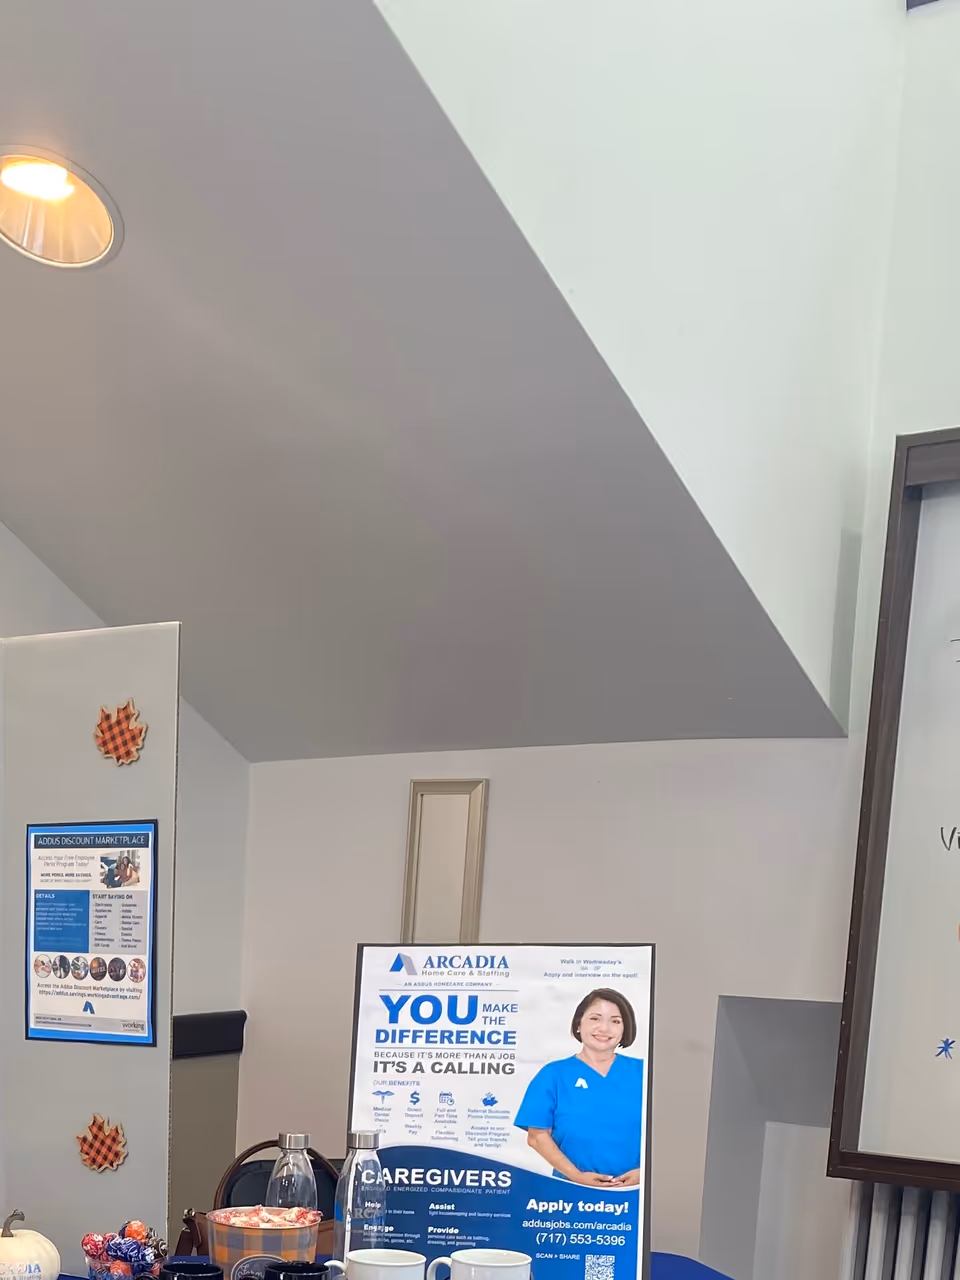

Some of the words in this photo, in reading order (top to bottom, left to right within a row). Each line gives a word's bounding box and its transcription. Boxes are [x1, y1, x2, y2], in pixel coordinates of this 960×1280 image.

[38, 837, 60, 845] ADDUS
[61, 837, 95, 845] DISCOUNT
[95, 836, 145, 845] MARKETPLACE
[423, 955, 509, 969] ARCADIA
[477, 970, 510, 978] Staffing
[92, 985, 118, 993] Marketplace
[379, 994, 479, 1025] YOU
[482, 1003, 519, 1013] MAKE
[481, 1016, 506, 1025] THE
[122, 1022, 145, 1032] working
[375, 1029, 517, 1045] DIFFERENCE
[374, 1051, 415, 1059] BECAUSE
[373, 1060, 407, 1074] IT'S
[412, 1061, 425, 1074] A
[430, 1061, 515, 1075] CALLING
[361, 1167, 512, 1188] CAREGIVERS
[429, 1202, 455, 1211] Assist
[526, 1198, 574, 1214] Apply
[577, 1200, 629, 1216] today!
[427, 1226, 459, 1234] Provide
[522, 1219, 632, 1231] addusjobs.com/arcadia
[536, 1232, 567, 1246] (717)
[569, 1233, 626, 1246] 553-5396
